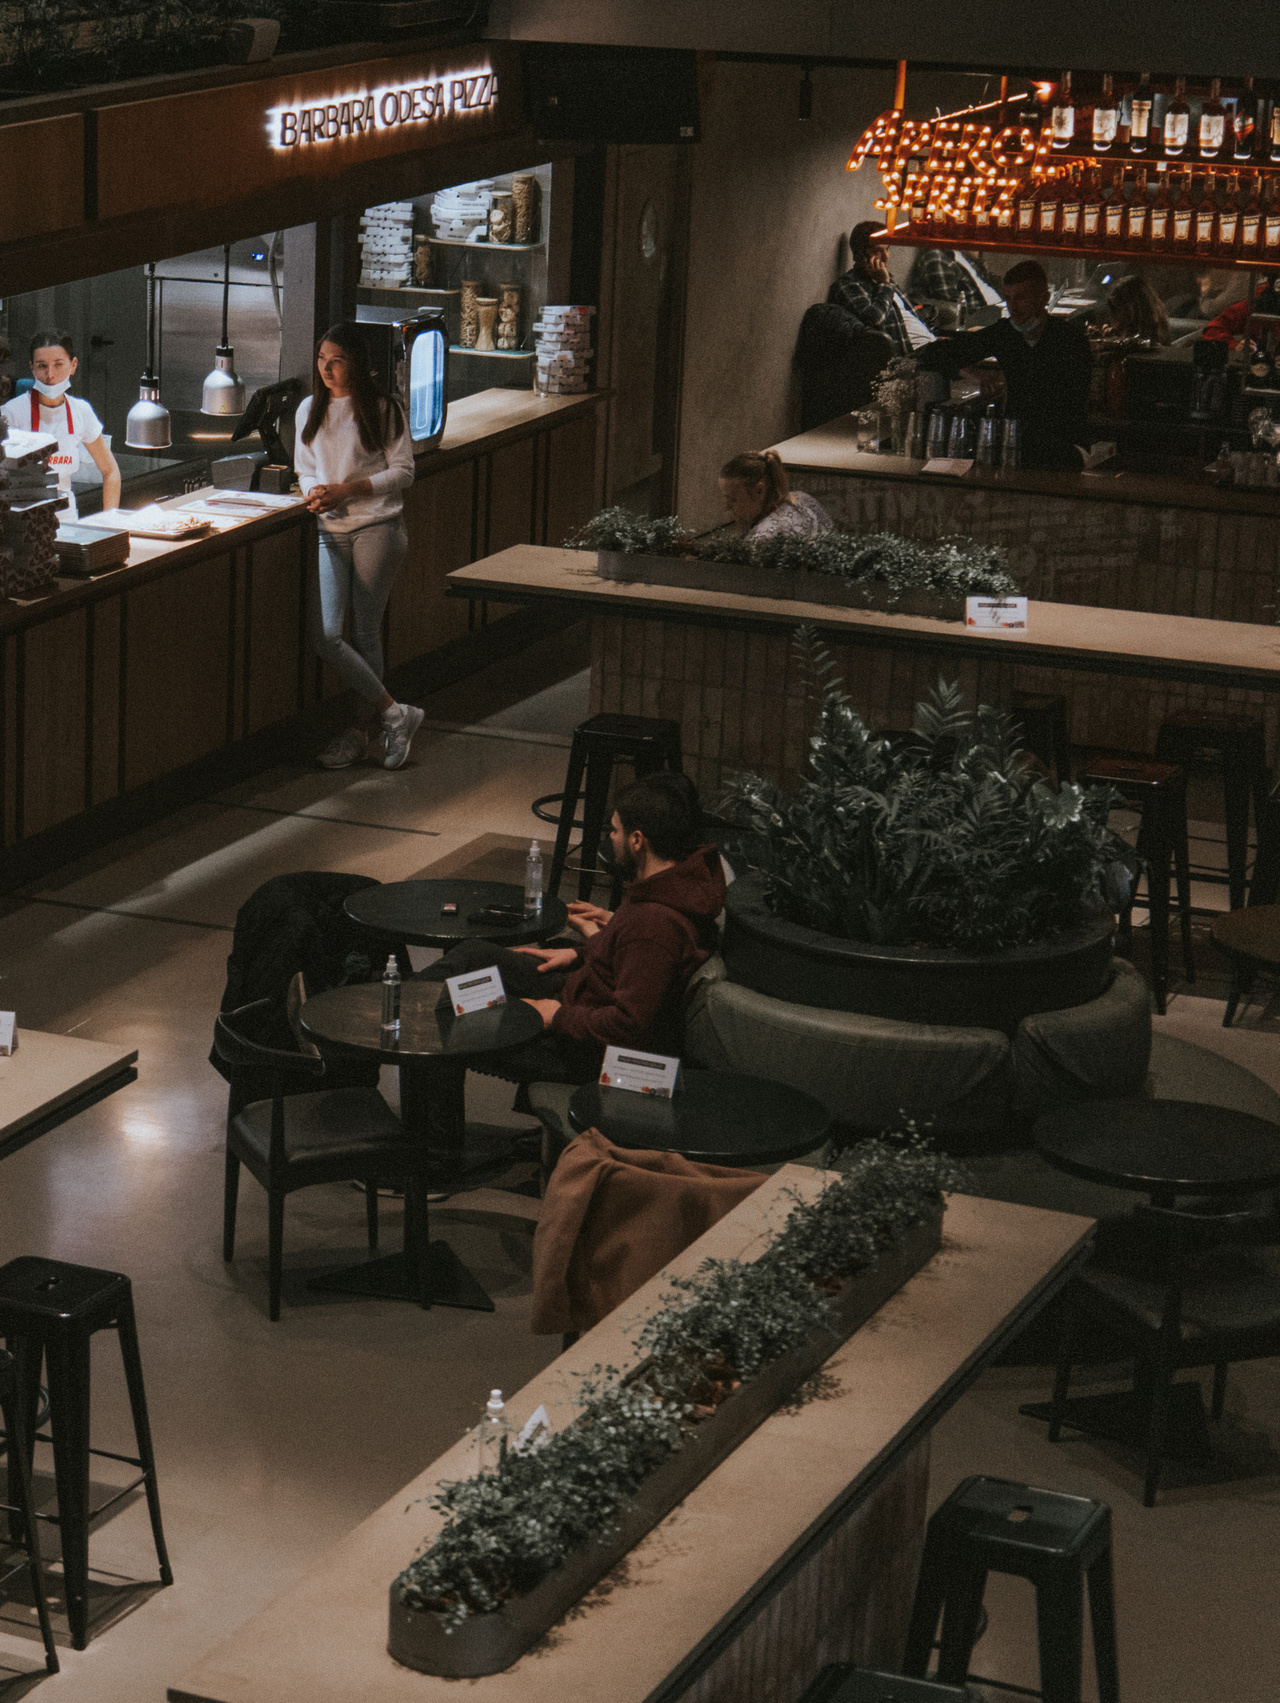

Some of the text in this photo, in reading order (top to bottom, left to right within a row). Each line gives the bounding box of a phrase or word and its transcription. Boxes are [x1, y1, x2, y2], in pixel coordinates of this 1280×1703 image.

[280, 71, 499, 147] BARBARA ODESA PIZZA
[846, 110, 1057, 177] APEROL
[48, 455, 73, 466] RBARA
